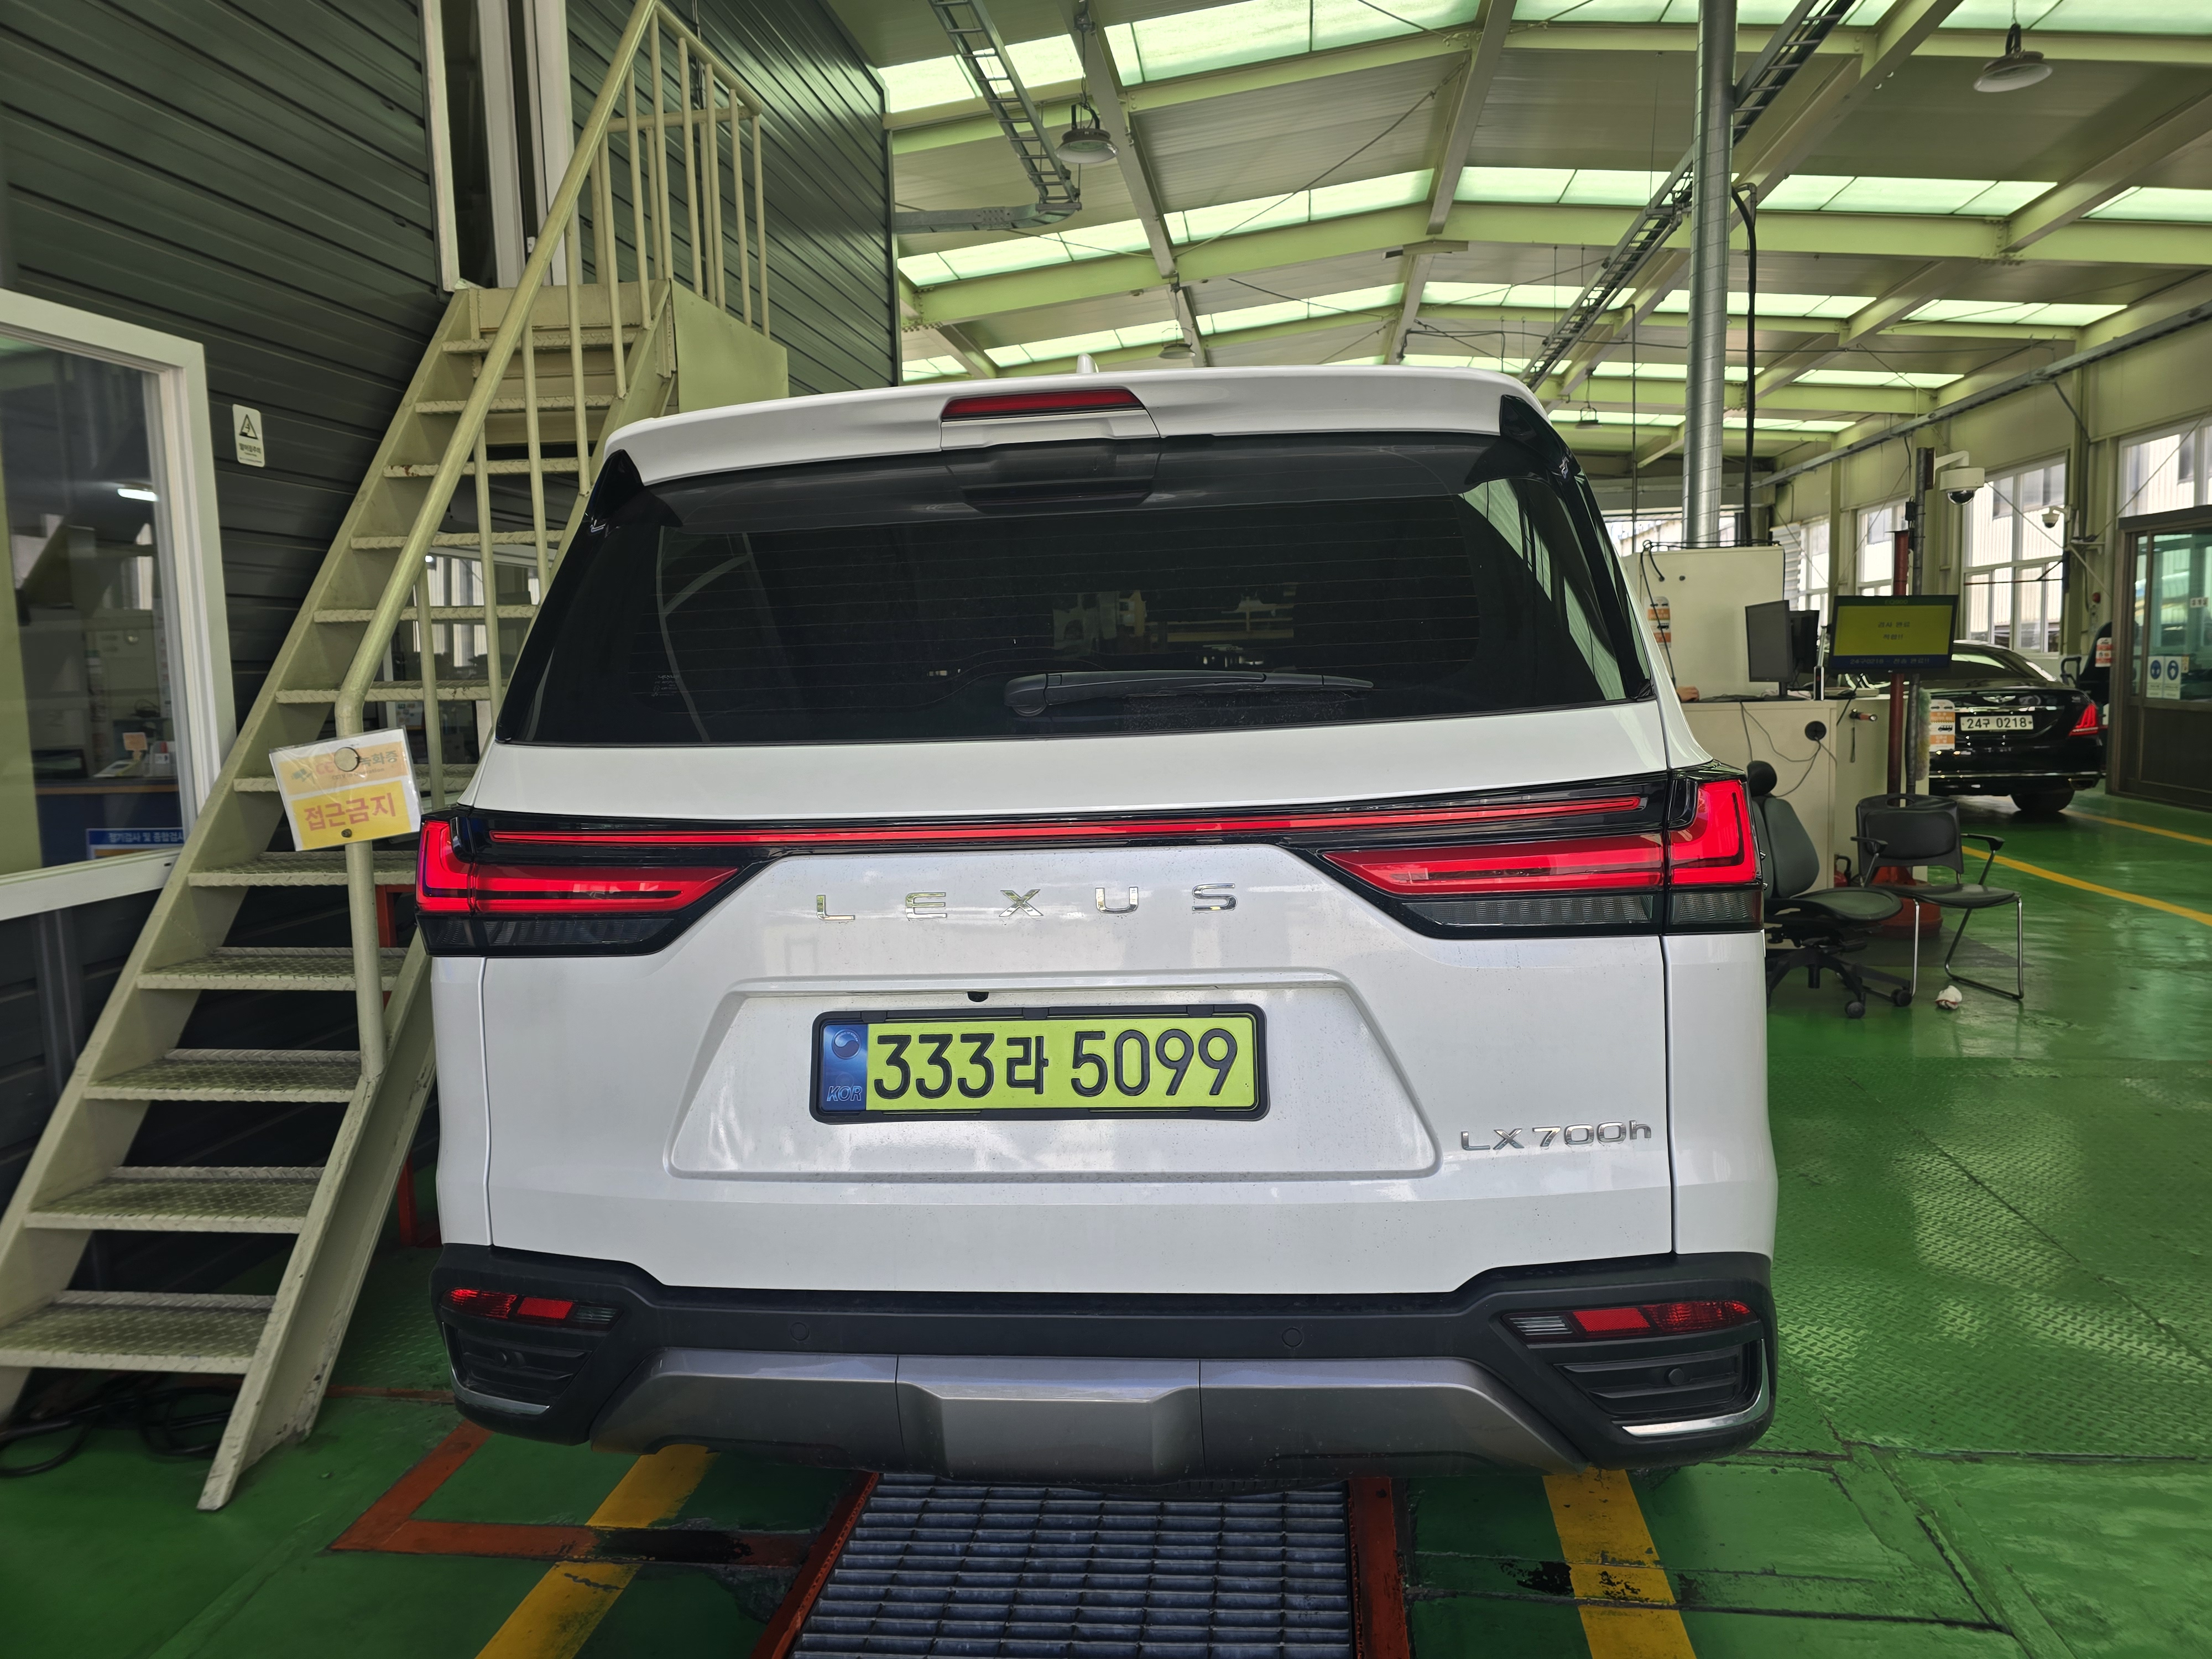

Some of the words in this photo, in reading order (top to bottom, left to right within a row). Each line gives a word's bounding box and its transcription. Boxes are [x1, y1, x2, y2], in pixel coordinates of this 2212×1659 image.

[1967, 718, 1990, 729] 24구
[1996, 717, 2027, 728] 0218
[304, 792, 396, 831] 접근금지
[816, 883, 1238, 921] LEXUS
[874, 1032, 1049, 1099] 333라
[1071, 1028, 1238, 1097] 5099
[826, 1086, 863, 1102] KOR
[1460, 1128, 1525, 1151] LX
[1532, 1120, 1652, 1147] 700h
